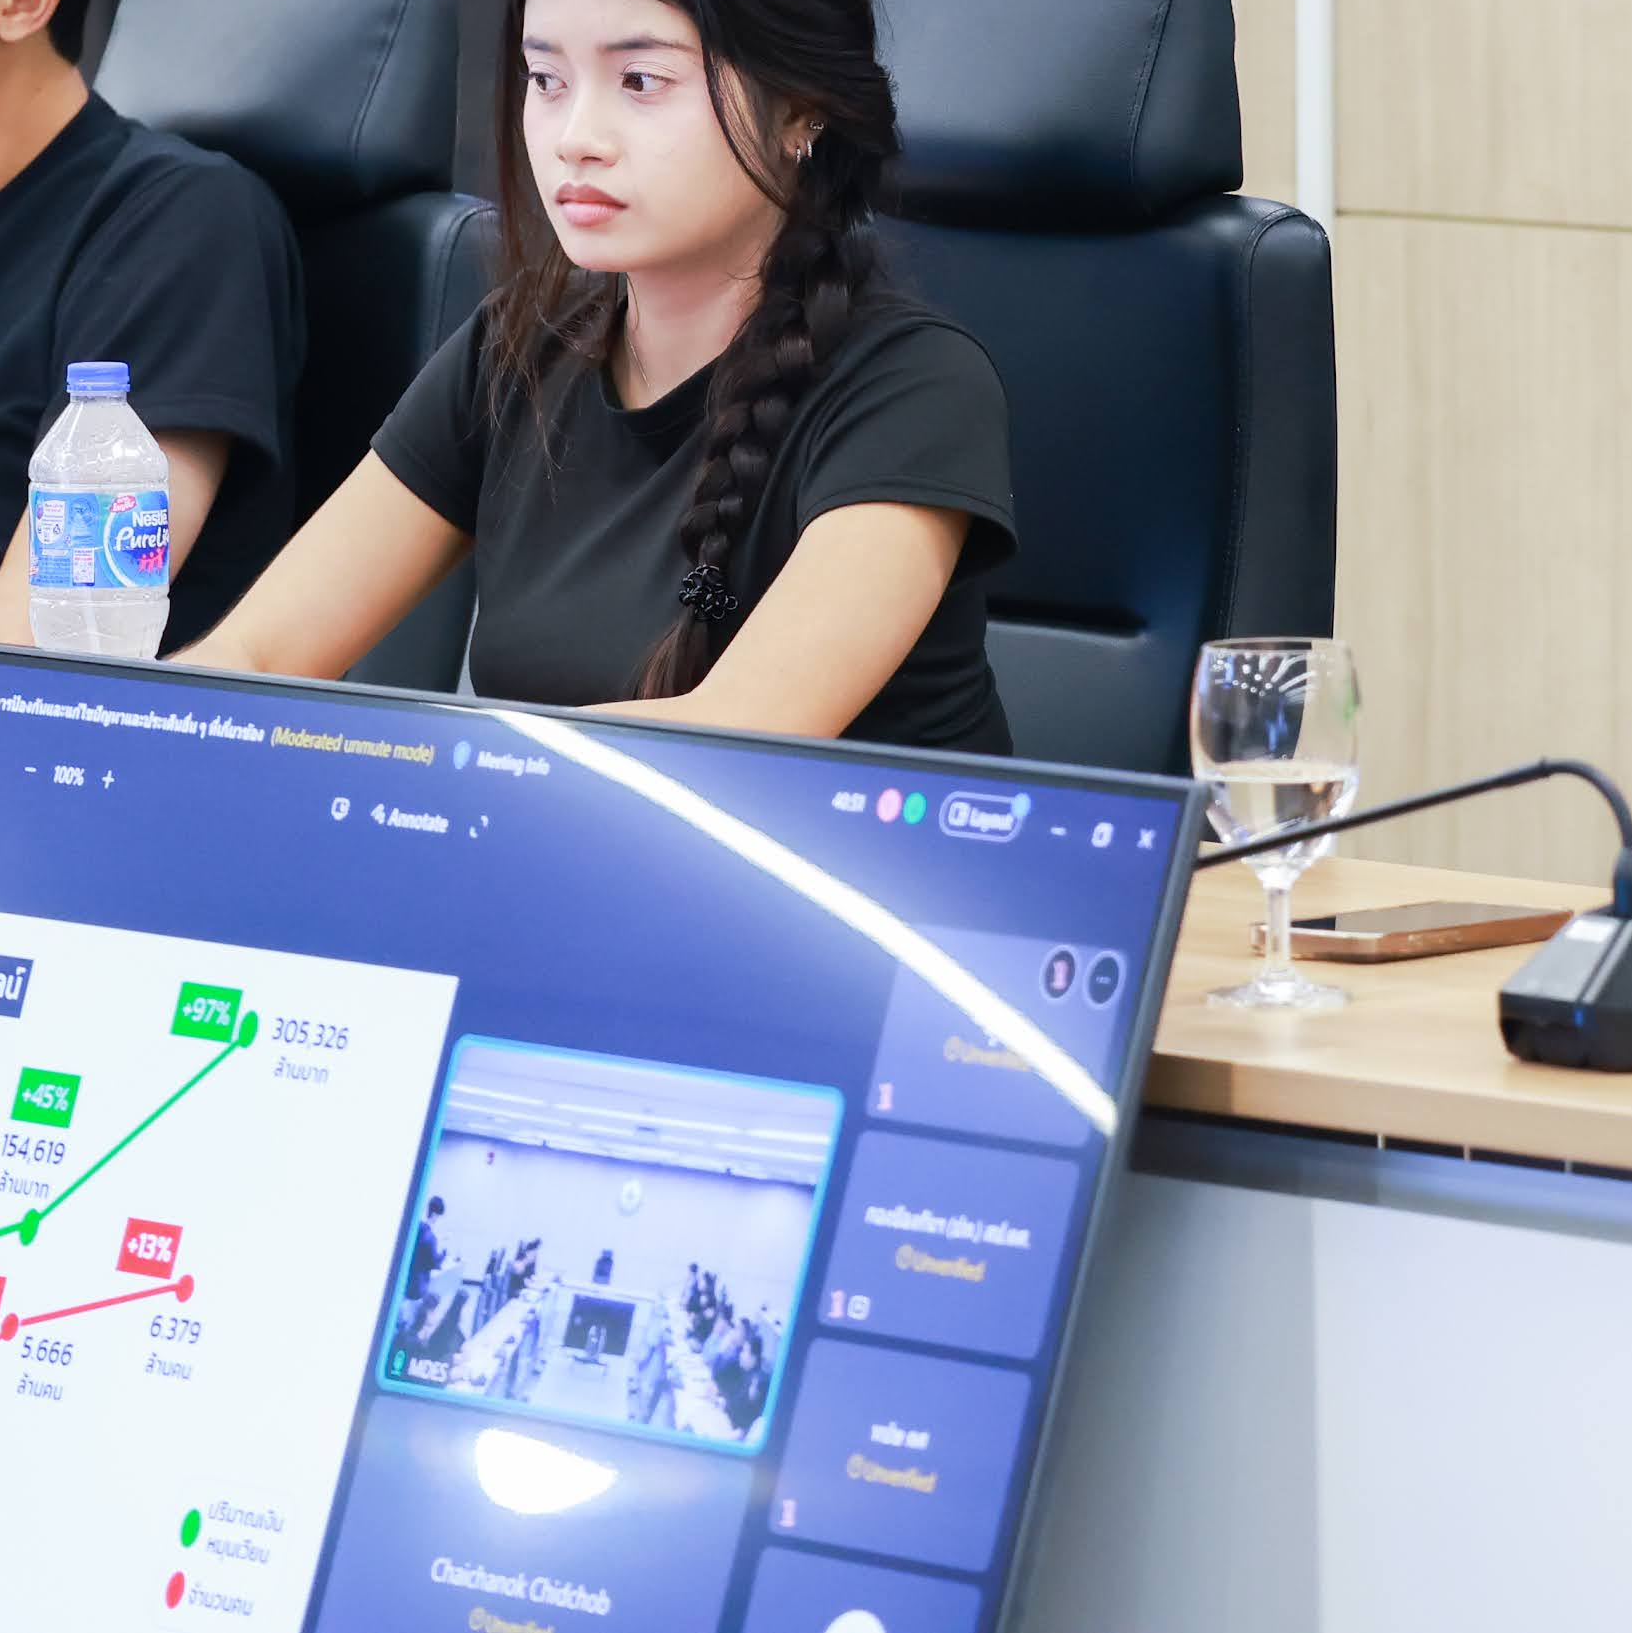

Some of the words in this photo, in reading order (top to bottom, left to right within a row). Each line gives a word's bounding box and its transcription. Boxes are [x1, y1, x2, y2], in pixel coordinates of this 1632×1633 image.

[270, 726, 343, 753] (Moderated
[393, 744, 435, 766] mode)
[53, 765, 85, 787] 100%
[387, 807, 450, 834] Annotate
[181, 996, 232, 1027] +97%
[270, 1017, 350, 1051] 305,326
[21, 1083, 70, 1113] +45%
[0, 1133, 66, 1166] 154,619
[126, 1233, 173, 1264] +13%
[149, 1314, 202, 1345] 6.379
[21, 1336, 75, 1367] 5.666
[430, 1556, 527, 1599] Chaichanok
